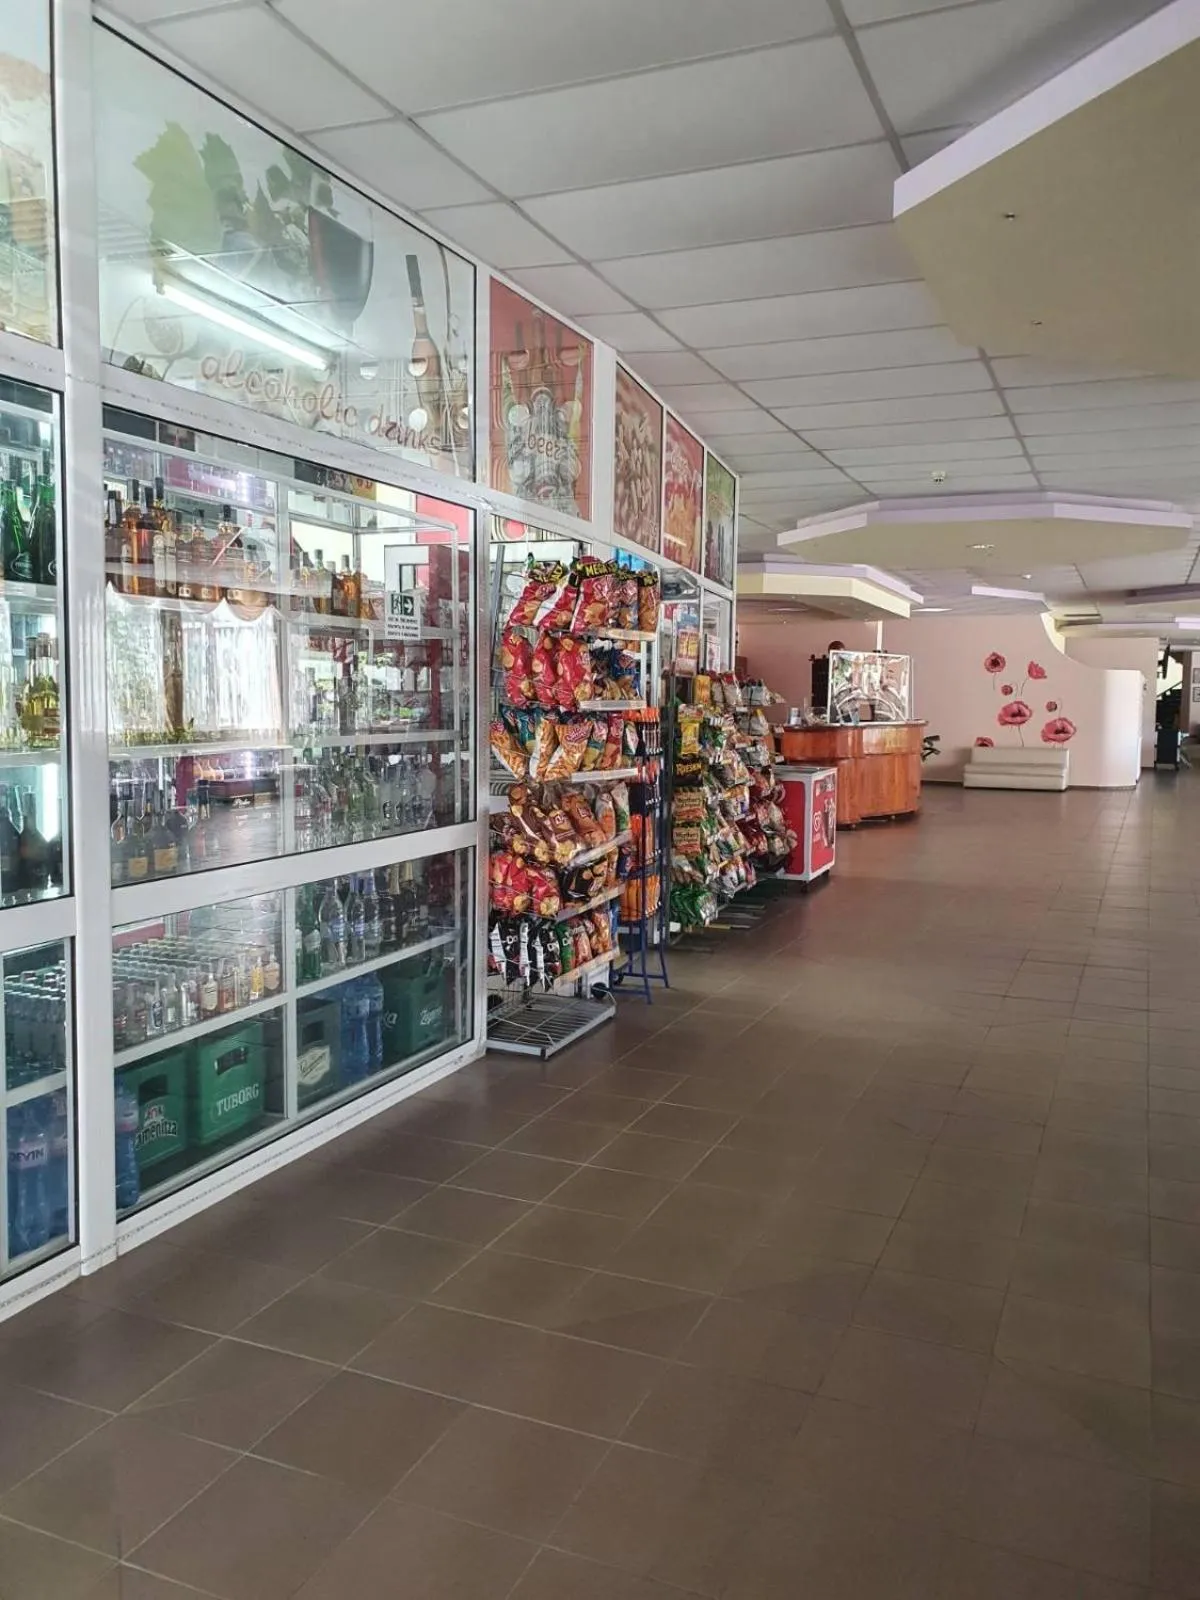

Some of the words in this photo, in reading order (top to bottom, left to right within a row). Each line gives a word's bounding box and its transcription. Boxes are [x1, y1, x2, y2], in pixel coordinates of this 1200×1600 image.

[201, 349, 359, 428] alcoholic
[368, 404, 442, 455] drinks
[216, 1083, 259, 1116] TUBORG
